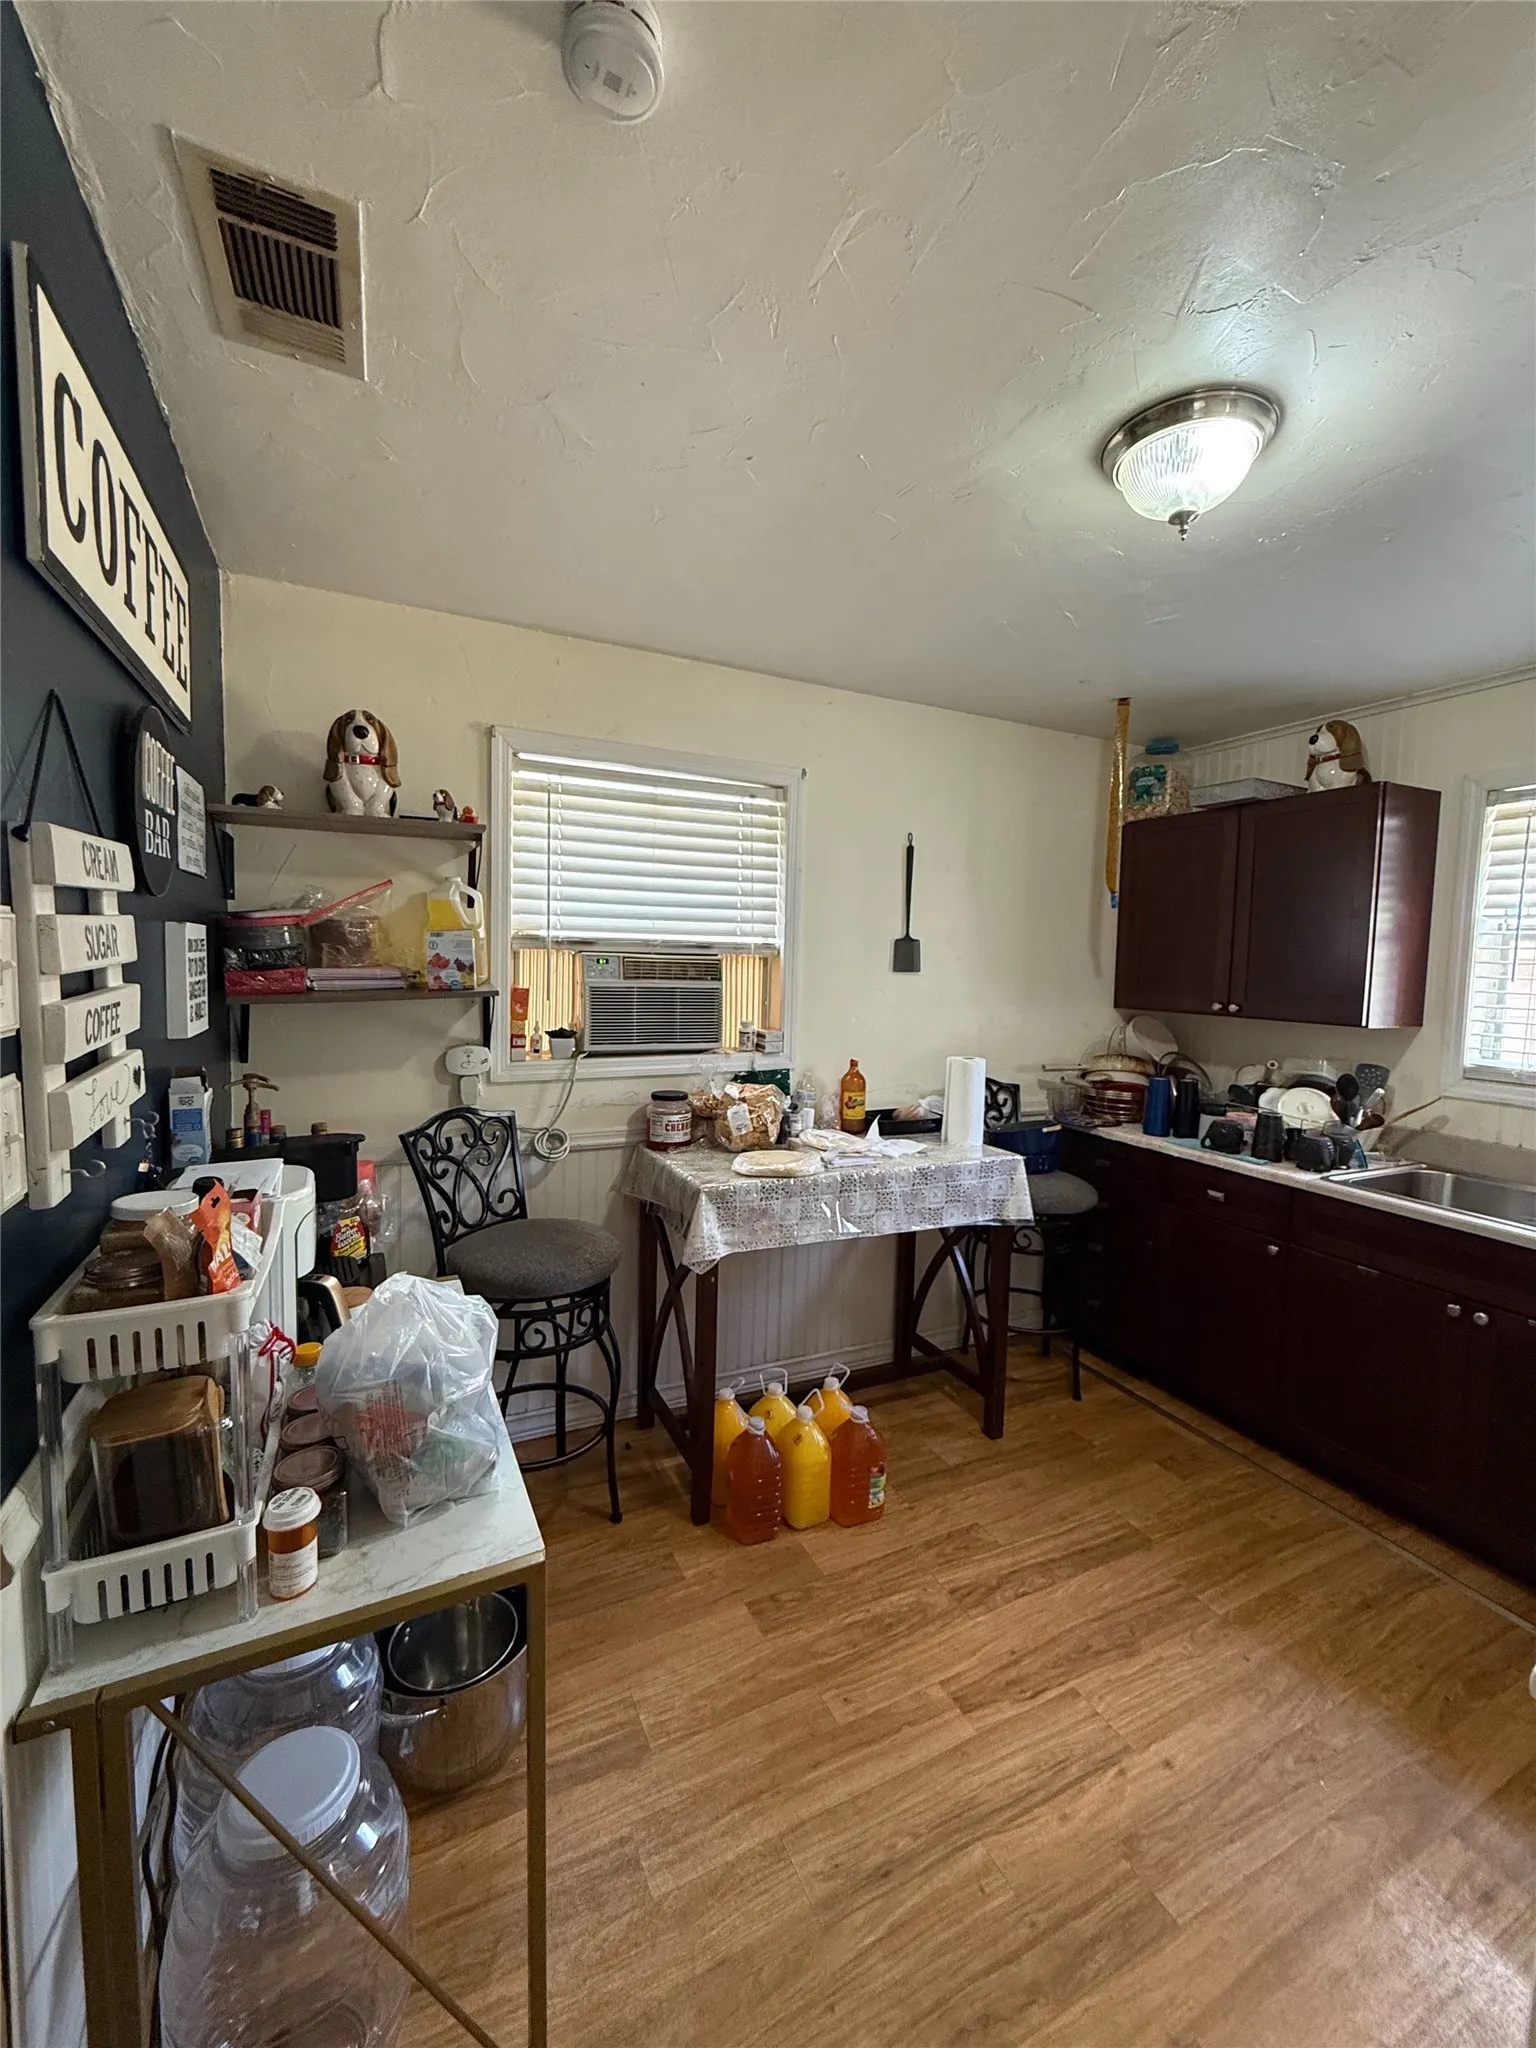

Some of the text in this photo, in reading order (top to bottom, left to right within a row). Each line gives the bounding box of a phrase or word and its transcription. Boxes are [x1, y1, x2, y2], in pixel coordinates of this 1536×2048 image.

[54, 372, 189, 693] COFFEE
[144, 808, 171, 859] BAR
[82, 840, 119, 883] CREAM
[85, 923, 119, 961] SUGAR
[85, 1001, 121, 1046] COFFEE
